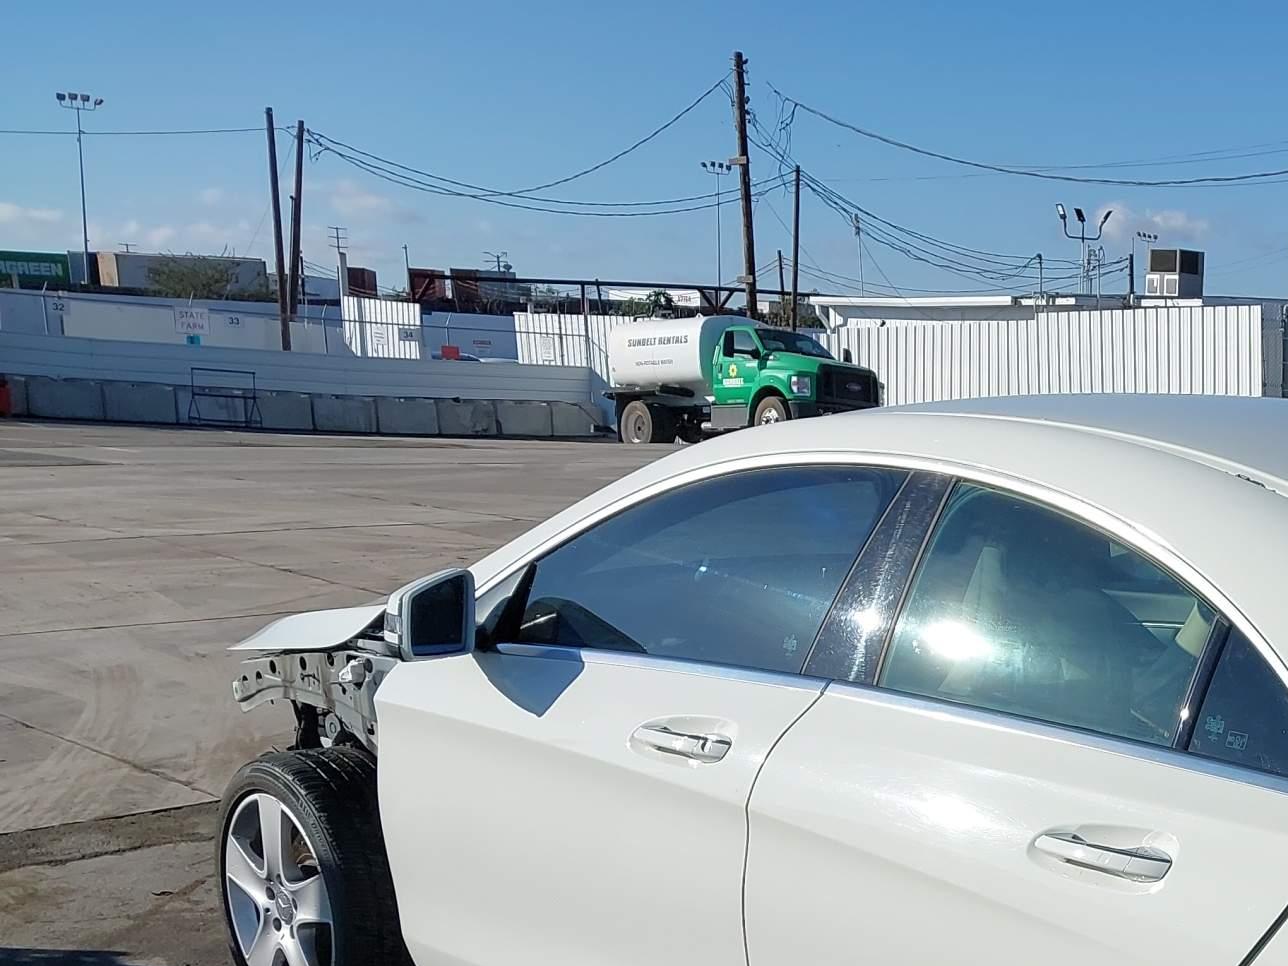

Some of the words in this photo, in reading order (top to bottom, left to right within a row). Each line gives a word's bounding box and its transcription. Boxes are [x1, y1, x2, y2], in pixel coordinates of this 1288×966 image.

[52, 302, 65, 312] 32
[180, 311, 204, 320] STATE
[181, 321, 204, 330] FARM
[228, 316, 240, 326] 33
[627, 337, 657, 347] SUNBELT
[658, 335, 688, 345] RENTALS
